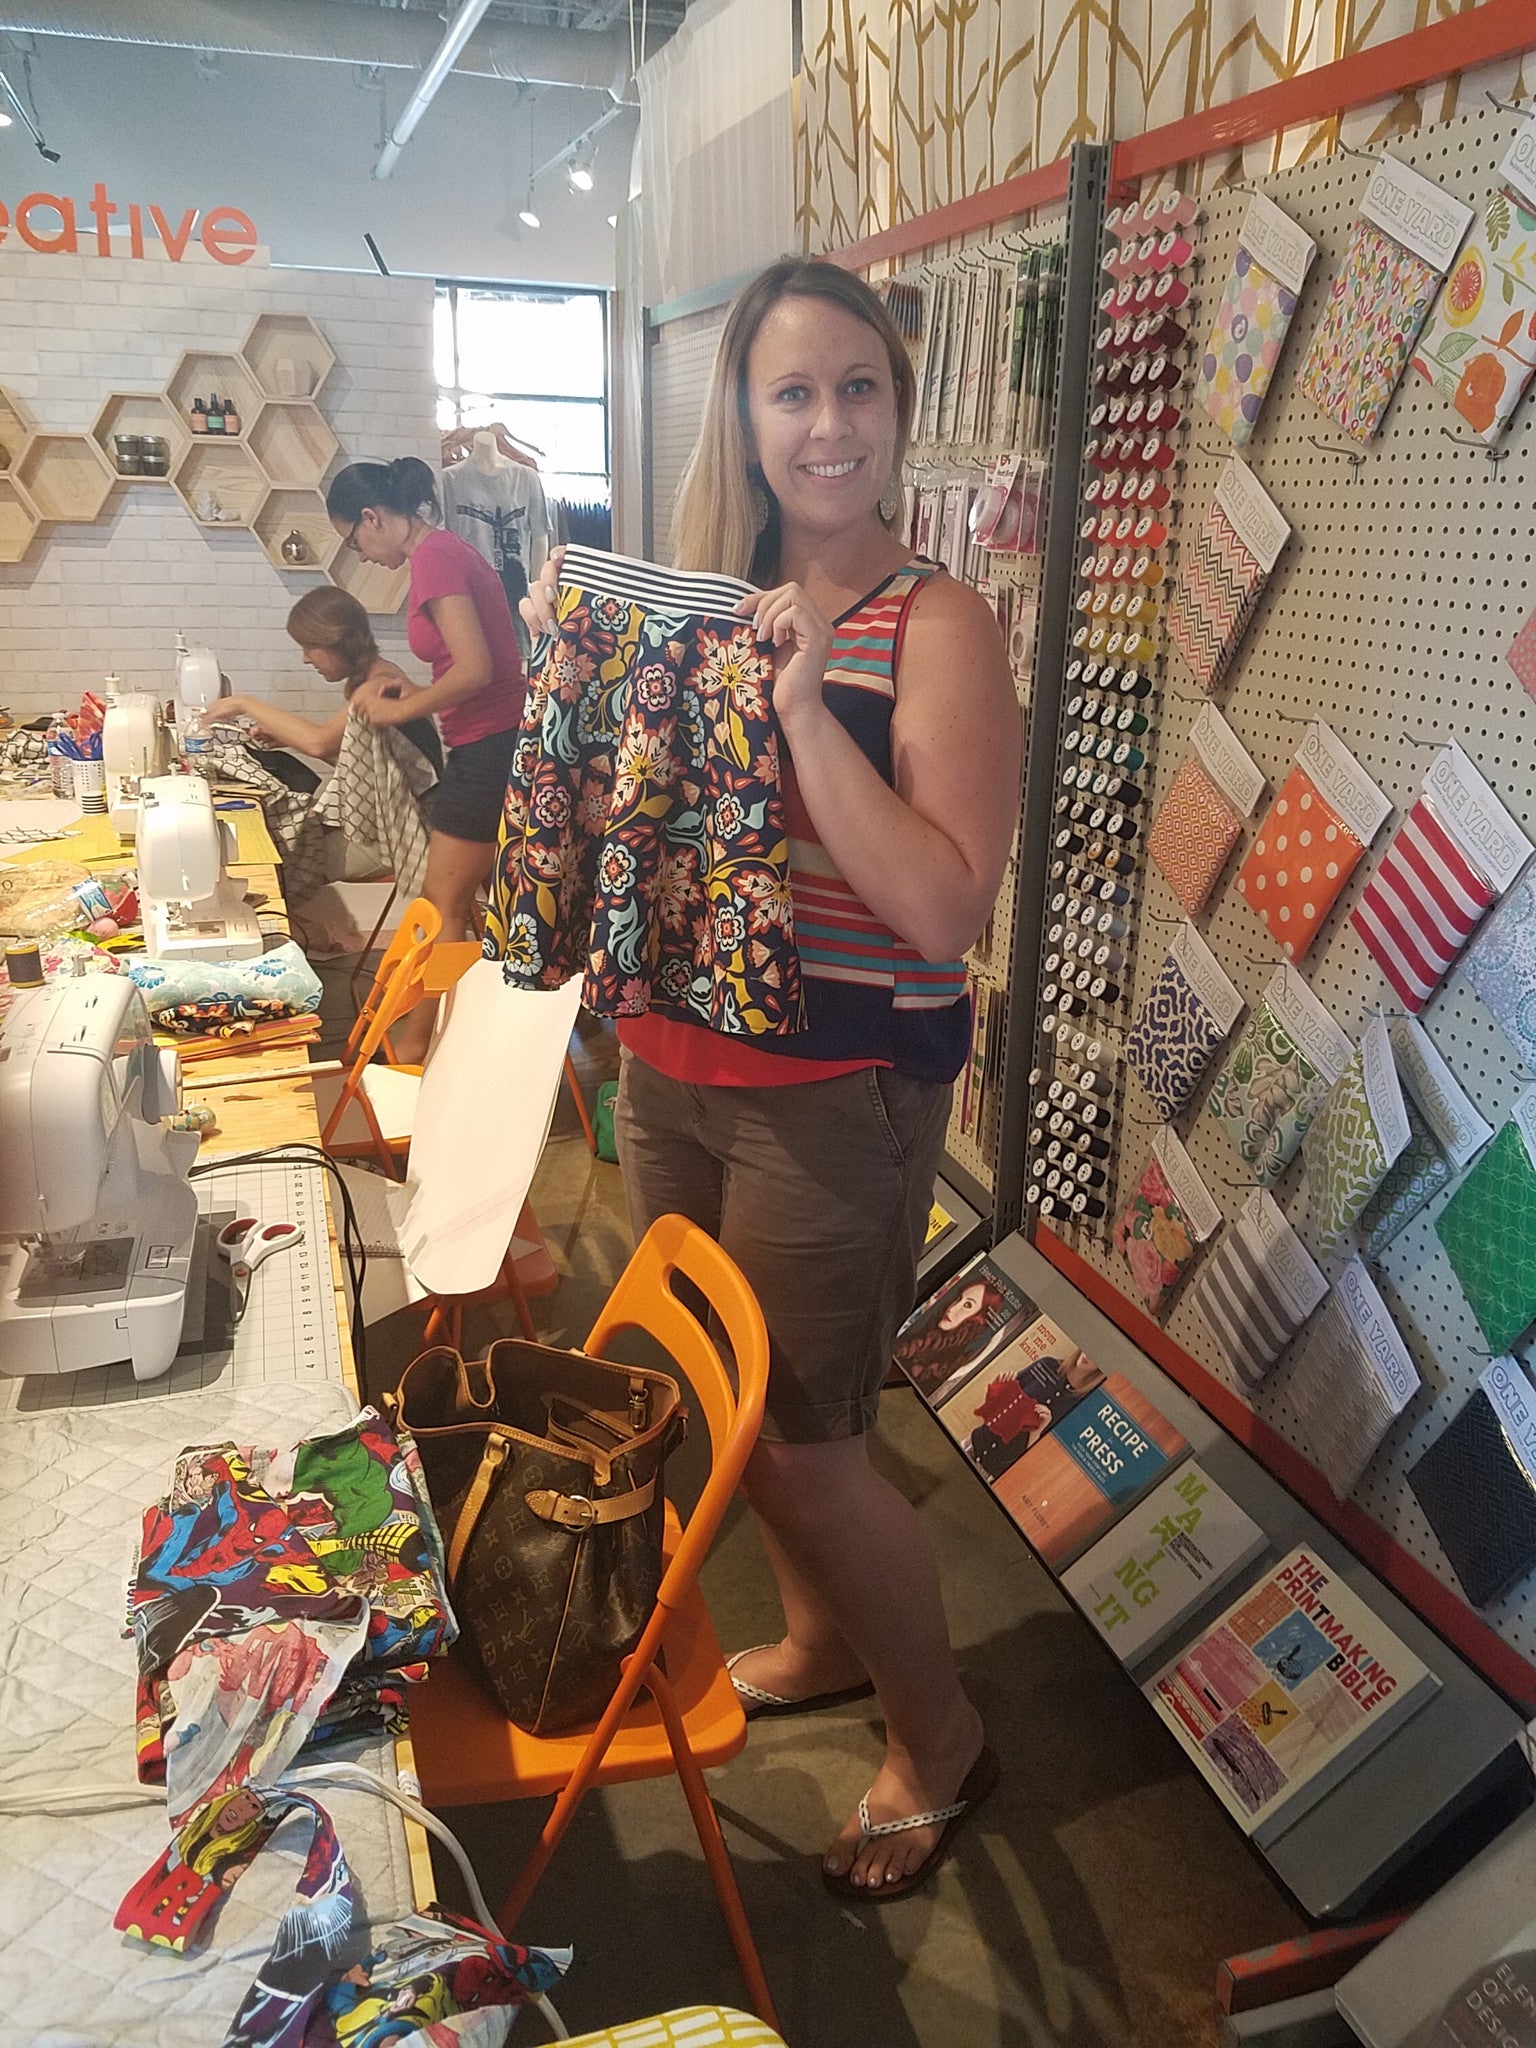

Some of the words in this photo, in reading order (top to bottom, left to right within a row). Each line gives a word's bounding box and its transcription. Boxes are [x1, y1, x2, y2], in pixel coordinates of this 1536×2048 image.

[0, 182, 258, 265] ative
[1371, 176, 1406, 216] ONE
[1403, 200, 1456, 250] YARD
[1199, 716, 1221, 756] ONE
[1219, 747, 1254, 801] YARD
[1306, 734, 1336, 779] ONE
[1332, 768, 1377, 828] YARD
[1435, 760, 1470, 811] ONE
[1464, 800, 1516, 871] YARD
[1273, 976, 1304, 1020] ONE
[1346, 1270, 1373, 1325] ONE
[1369, 1319, 1408, 1395] YARD
[1491, 1365, 1530, 1427] ONE
[1078, 1425, 1125, 1475] PRESS
[1097, 1403, 1149, 1459] RECIPE
[1292, 1554, 1329, 1594] THE
[1275, 1566, 1397, 1697] PRINTMAKING
[1325, 1652, 1382, 1712] BIBLE
[1482, 1978, 1510, 2006] OF
